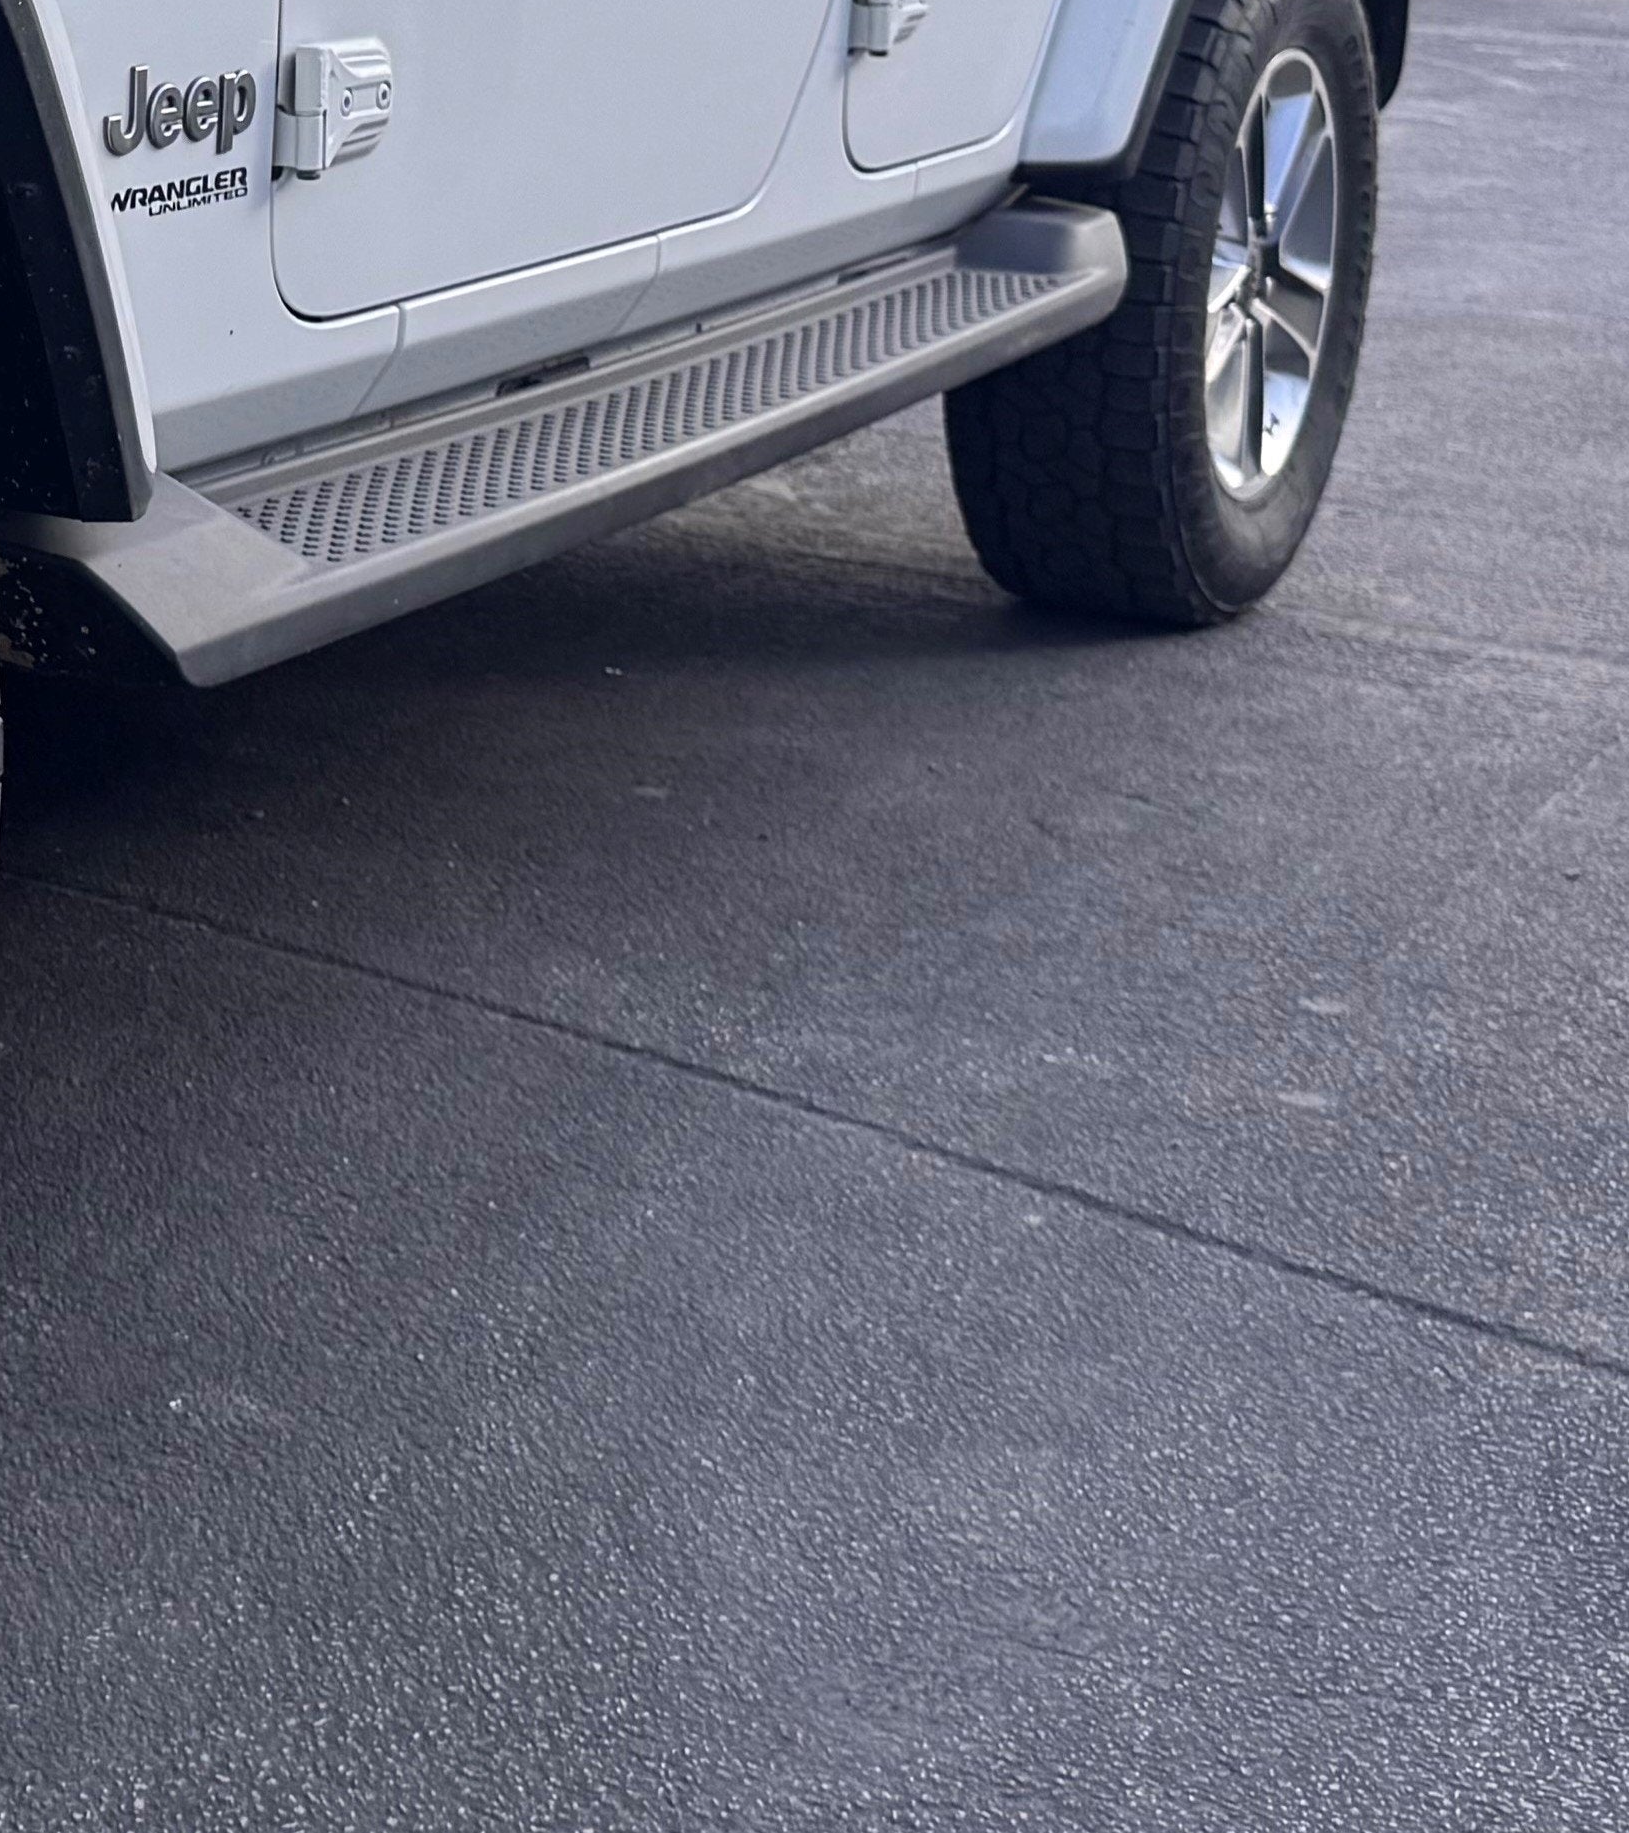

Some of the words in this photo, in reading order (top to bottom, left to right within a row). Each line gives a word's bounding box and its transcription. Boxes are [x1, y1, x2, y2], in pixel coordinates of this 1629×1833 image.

[102, 64, 257, 157] Jeep
[110, 165, 249, 213] WRANGLER
[148, 186, 249, 217] UNLIMITED
